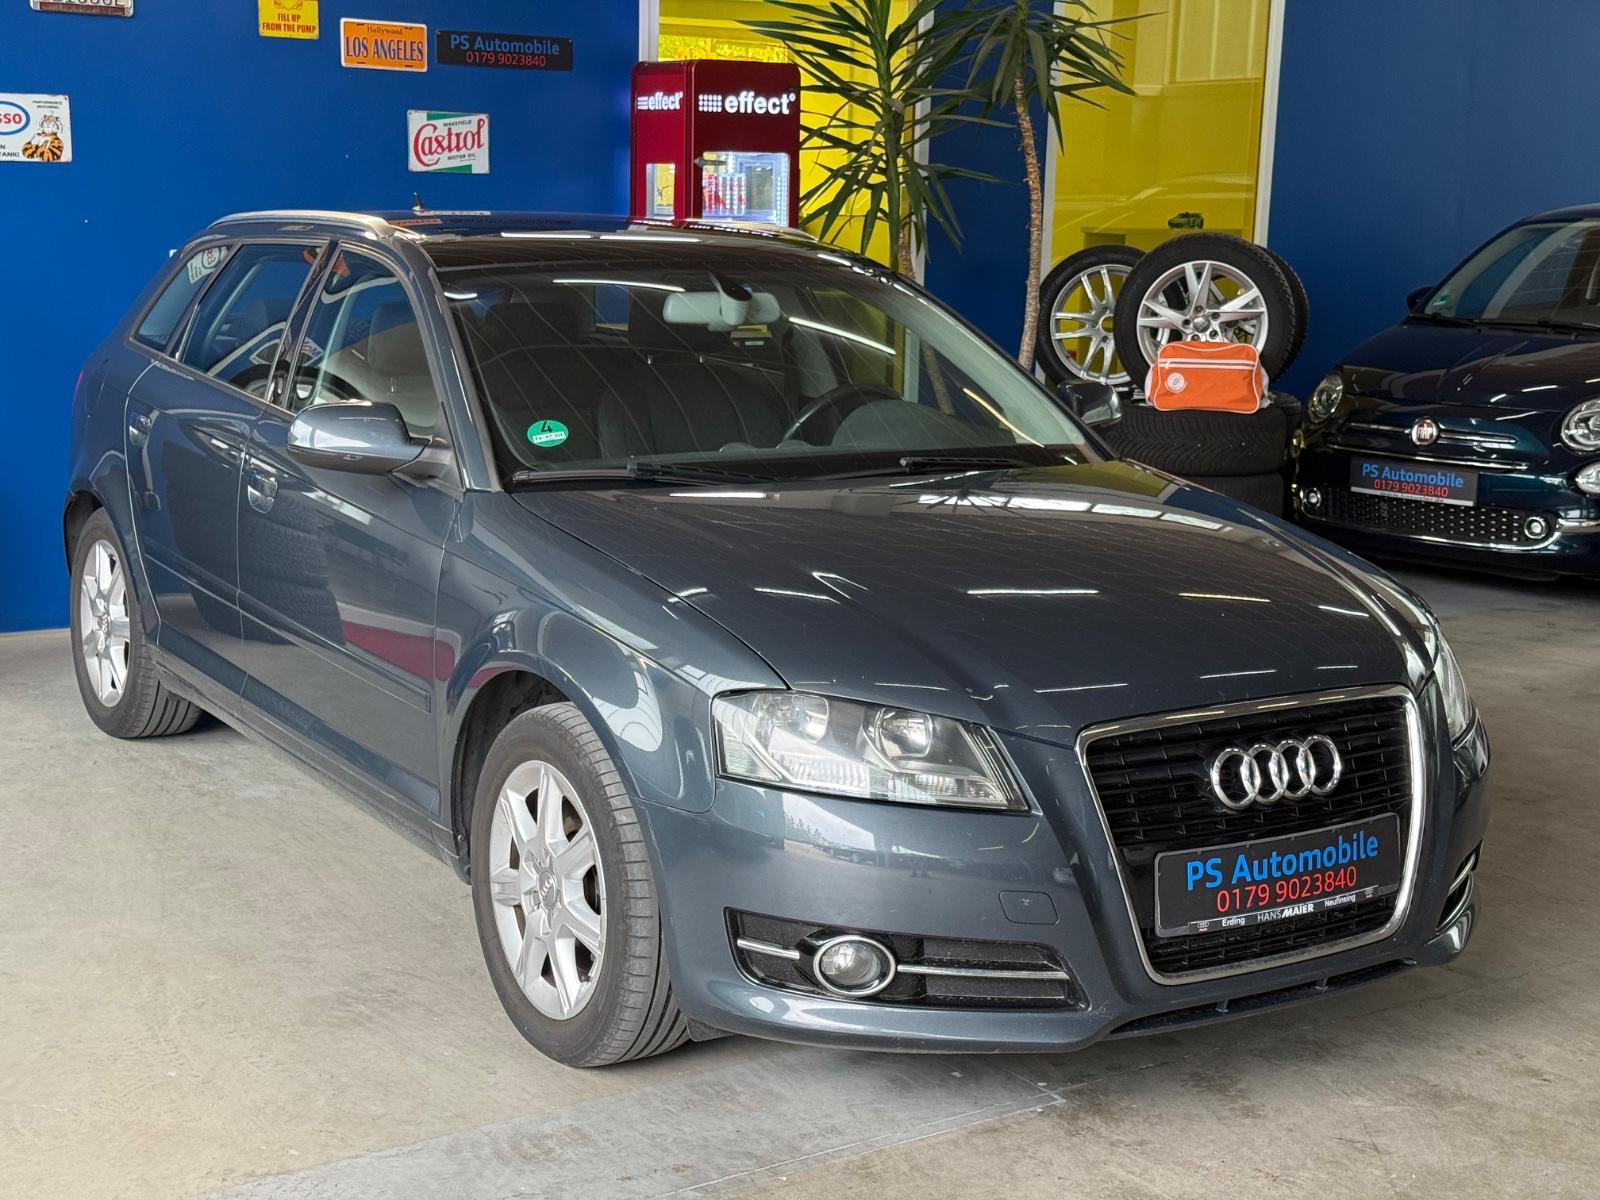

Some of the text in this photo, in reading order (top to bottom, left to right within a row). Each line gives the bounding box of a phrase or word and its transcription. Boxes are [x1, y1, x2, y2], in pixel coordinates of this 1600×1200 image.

[277, 13, 301, 22] FILL UP
[262, 22, 317, 33] FROM THE PUMP
[367, 26, 403, 35] Hollywood
[346, 36, 424, 62] LOS ANGELES
[450, 34, 560, 55] PS Automobile
[466, 51, 546, 67] 0179 9023840
[649, 92, 681, 110] effect
[724, 91, 790, 115] effect
[413, 118, 486, 168] Castrol
[540, 420, 553, 433] 4
[1362, 463, 1464, 488] PS Automobile
[1374, 479, 1400, 492] 0179
[1401, 482, 1449, 498] 9023840
[1187, 830, 1379, 891] PS Automobile
[1216, 866, 1357, 913] 0179 9023840
[1222, 916, 1246, 927] Erding
